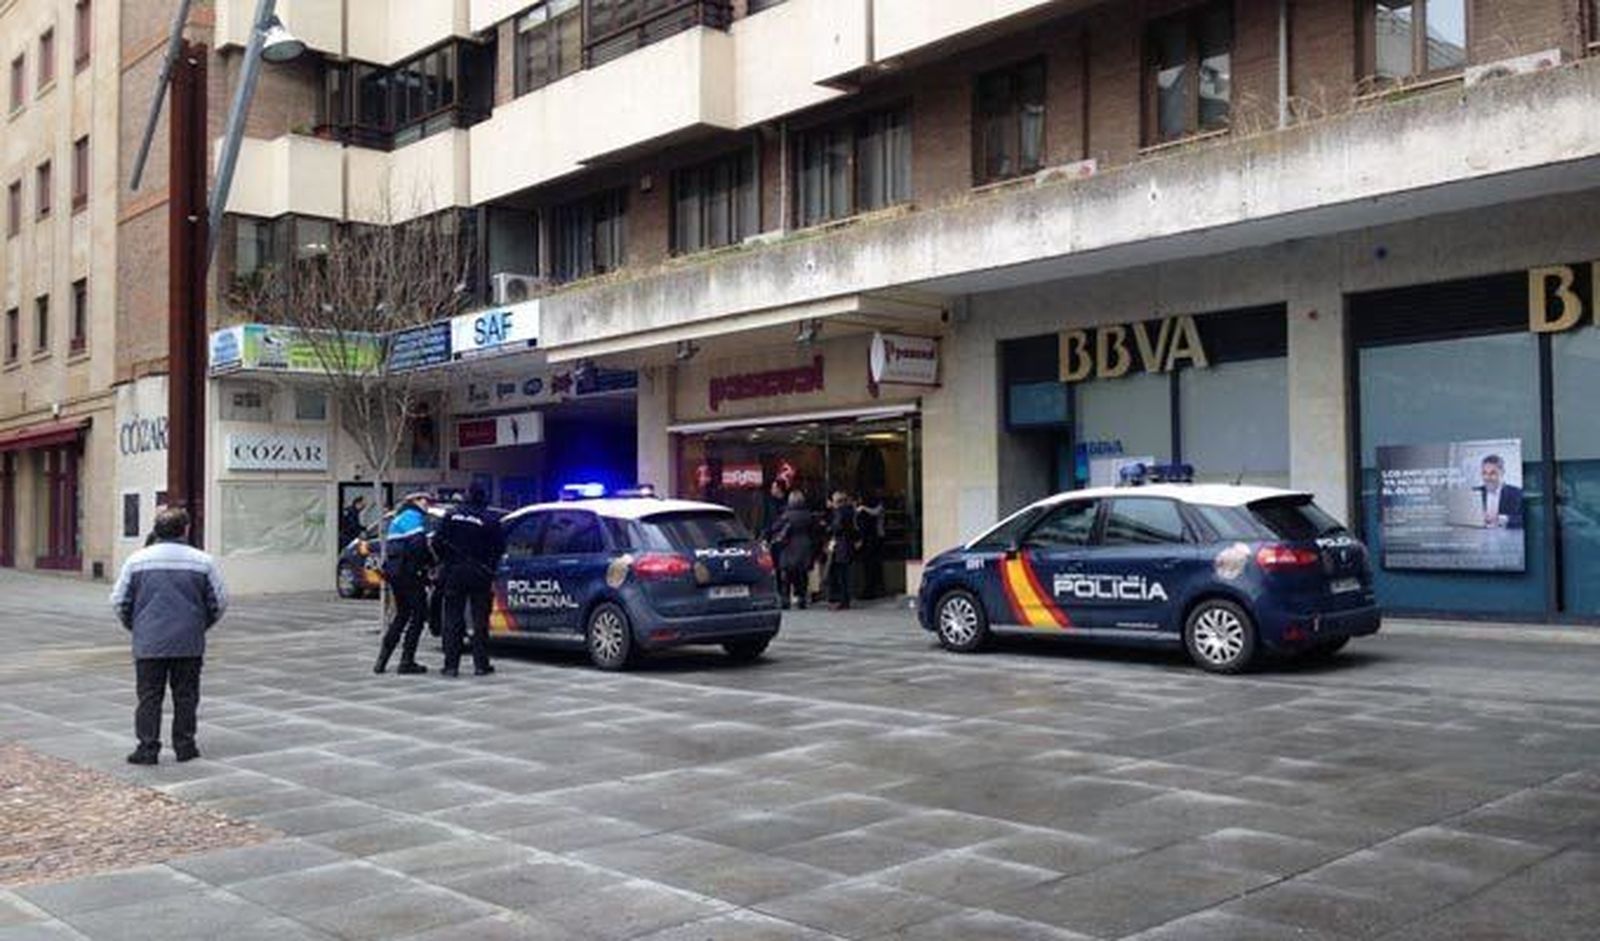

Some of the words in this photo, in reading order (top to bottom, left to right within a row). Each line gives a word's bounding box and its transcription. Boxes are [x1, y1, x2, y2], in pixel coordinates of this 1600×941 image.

[1529, 262, 1600, 333] B
[474, 311, 514, 345] SAF
[1058, 315, 1209, 382] BBVA
[507, 594, 579, 608] NACIONAL
